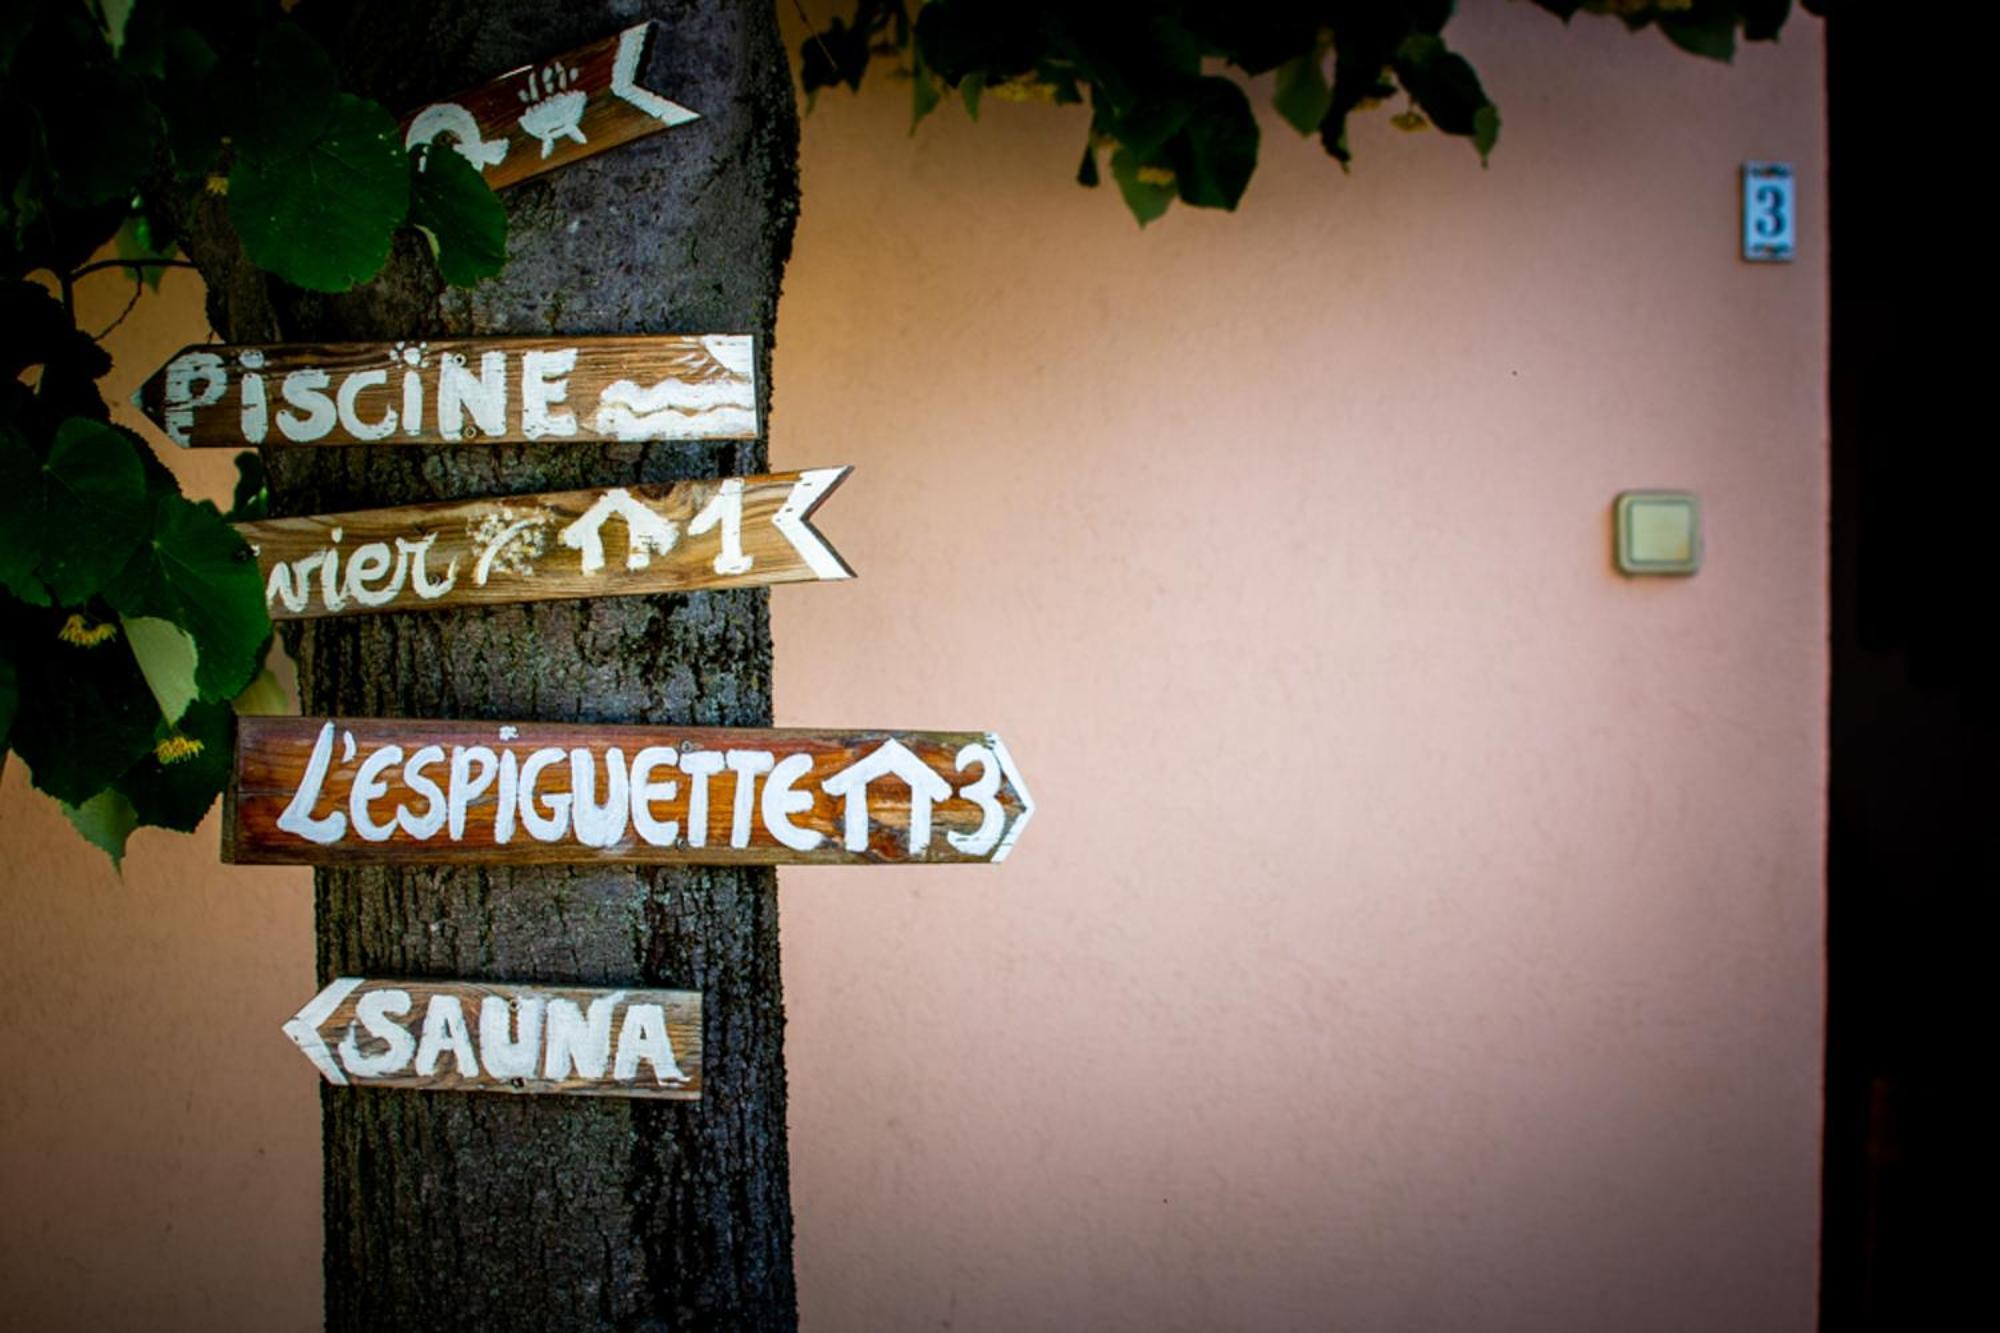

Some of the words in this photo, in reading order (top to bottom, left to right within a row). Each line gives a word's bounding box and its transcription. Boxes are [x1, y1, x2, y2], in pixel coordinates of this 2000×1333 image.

[1756, 186, 1786, 237] 3
[250, 526, 460, 614] vier
[688, 478, 753, 576] 1
[946, 743, 1003, 856] 3
[338, 990, 690, 1085] SAUNA
